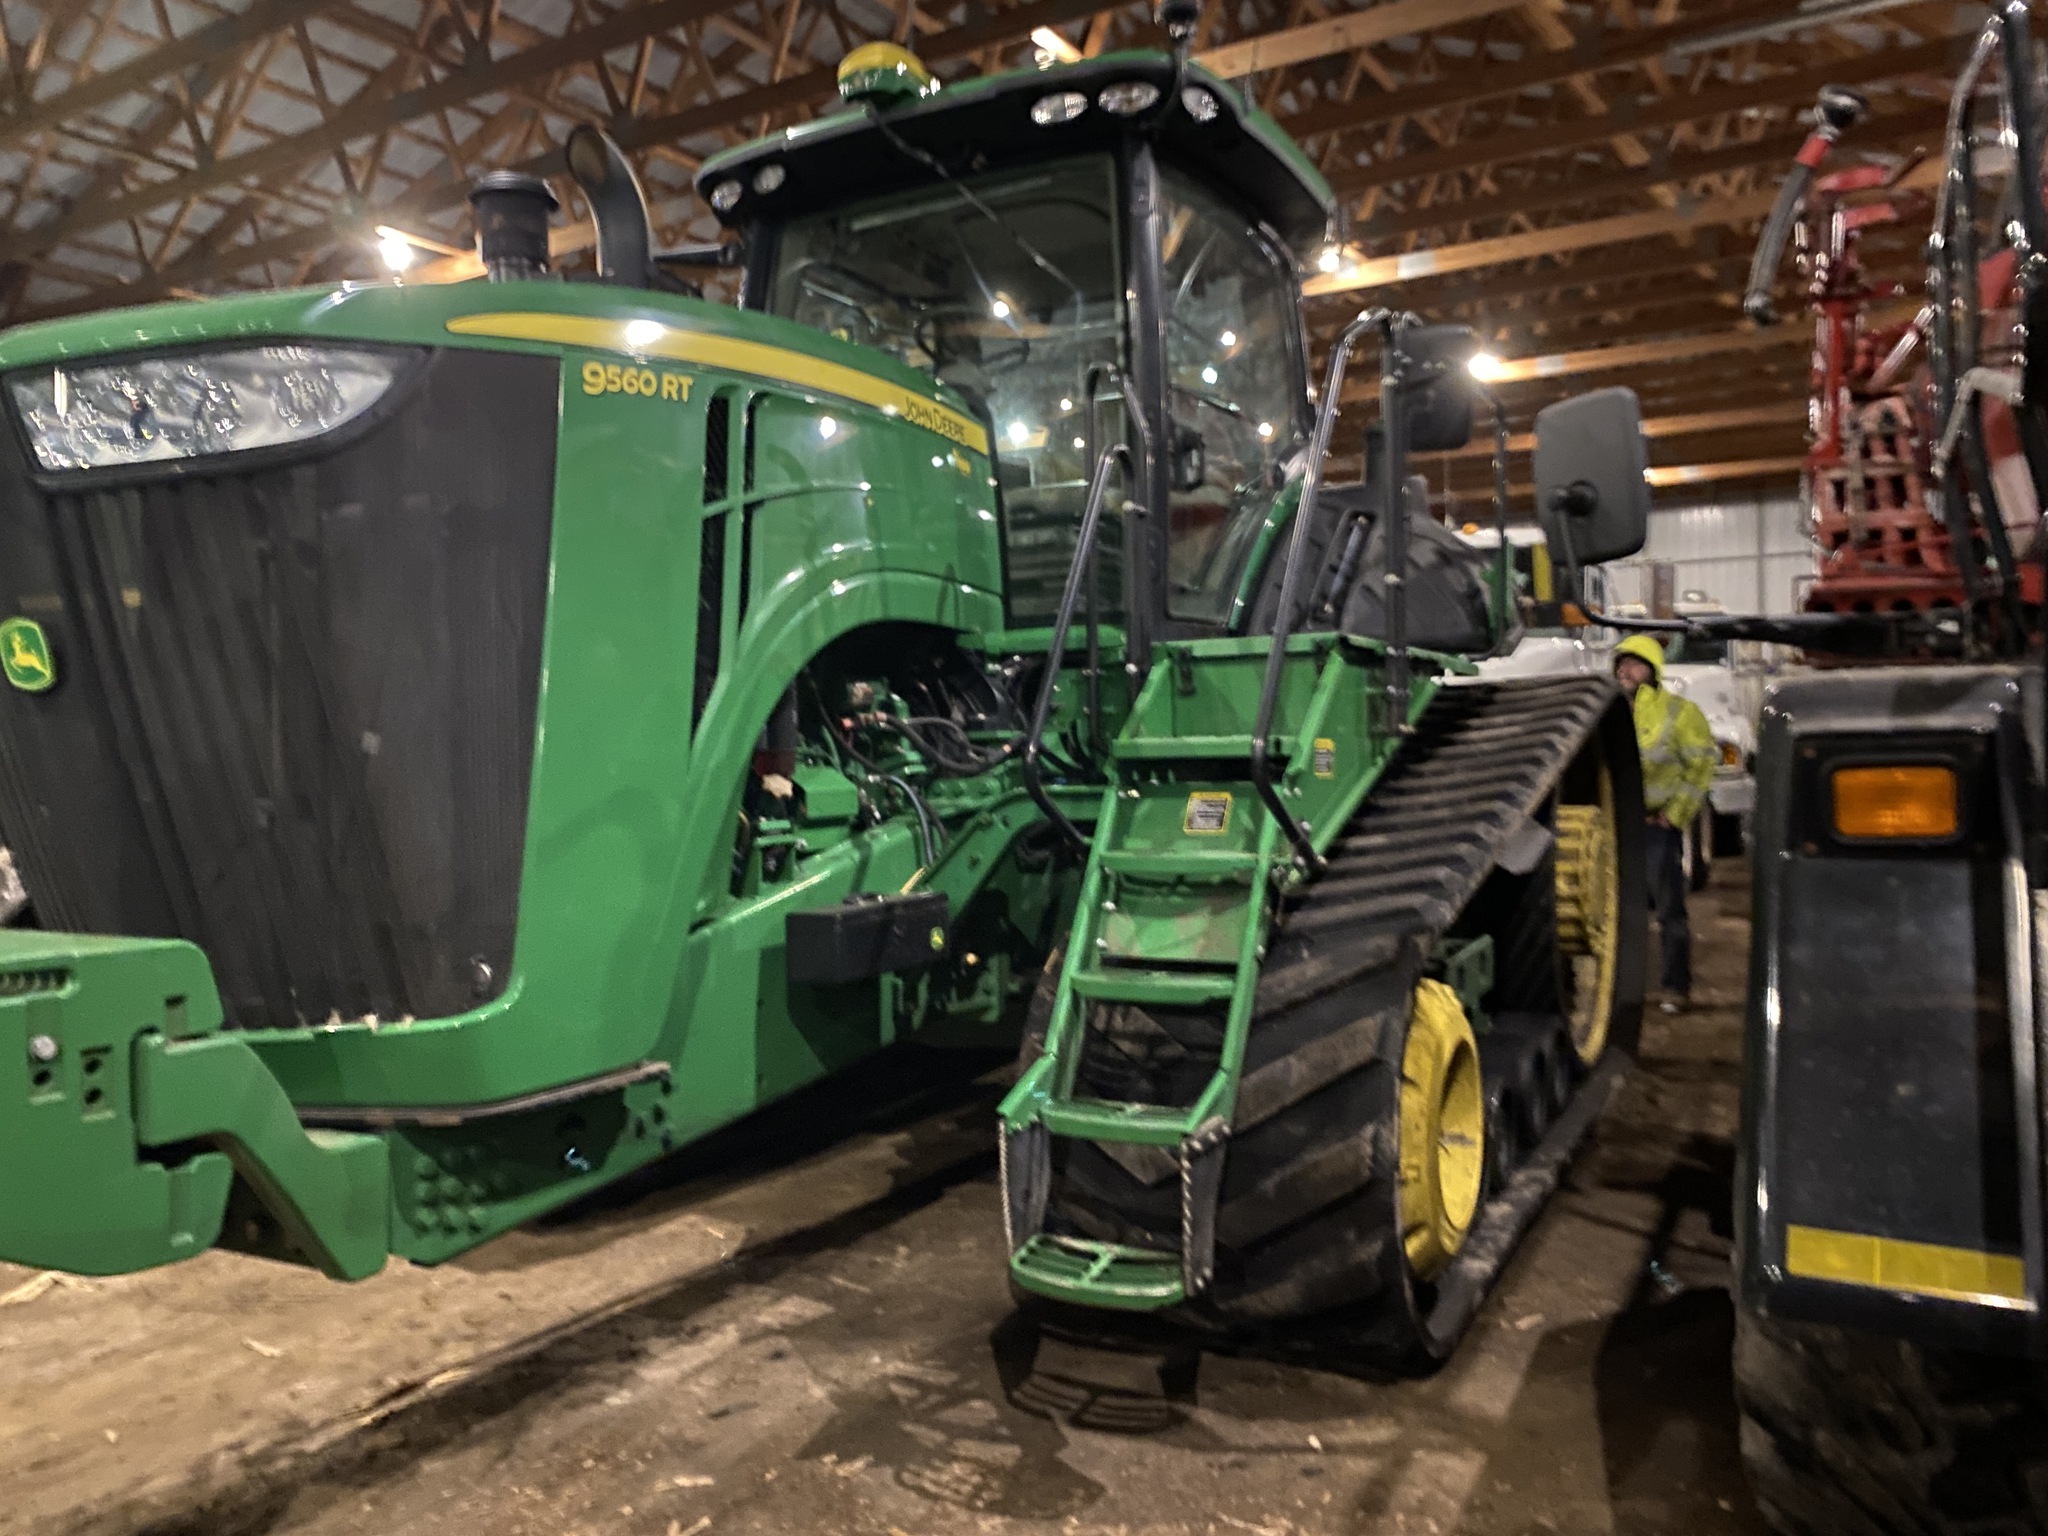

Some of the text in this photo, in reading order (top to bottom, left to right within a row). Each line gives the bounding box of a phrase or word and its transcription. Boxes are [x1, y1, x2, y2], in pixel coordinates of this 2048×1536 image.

[582, 360, 694, 403] 9560 RT
[904, 395, 966, 443] JOHN DEERE
